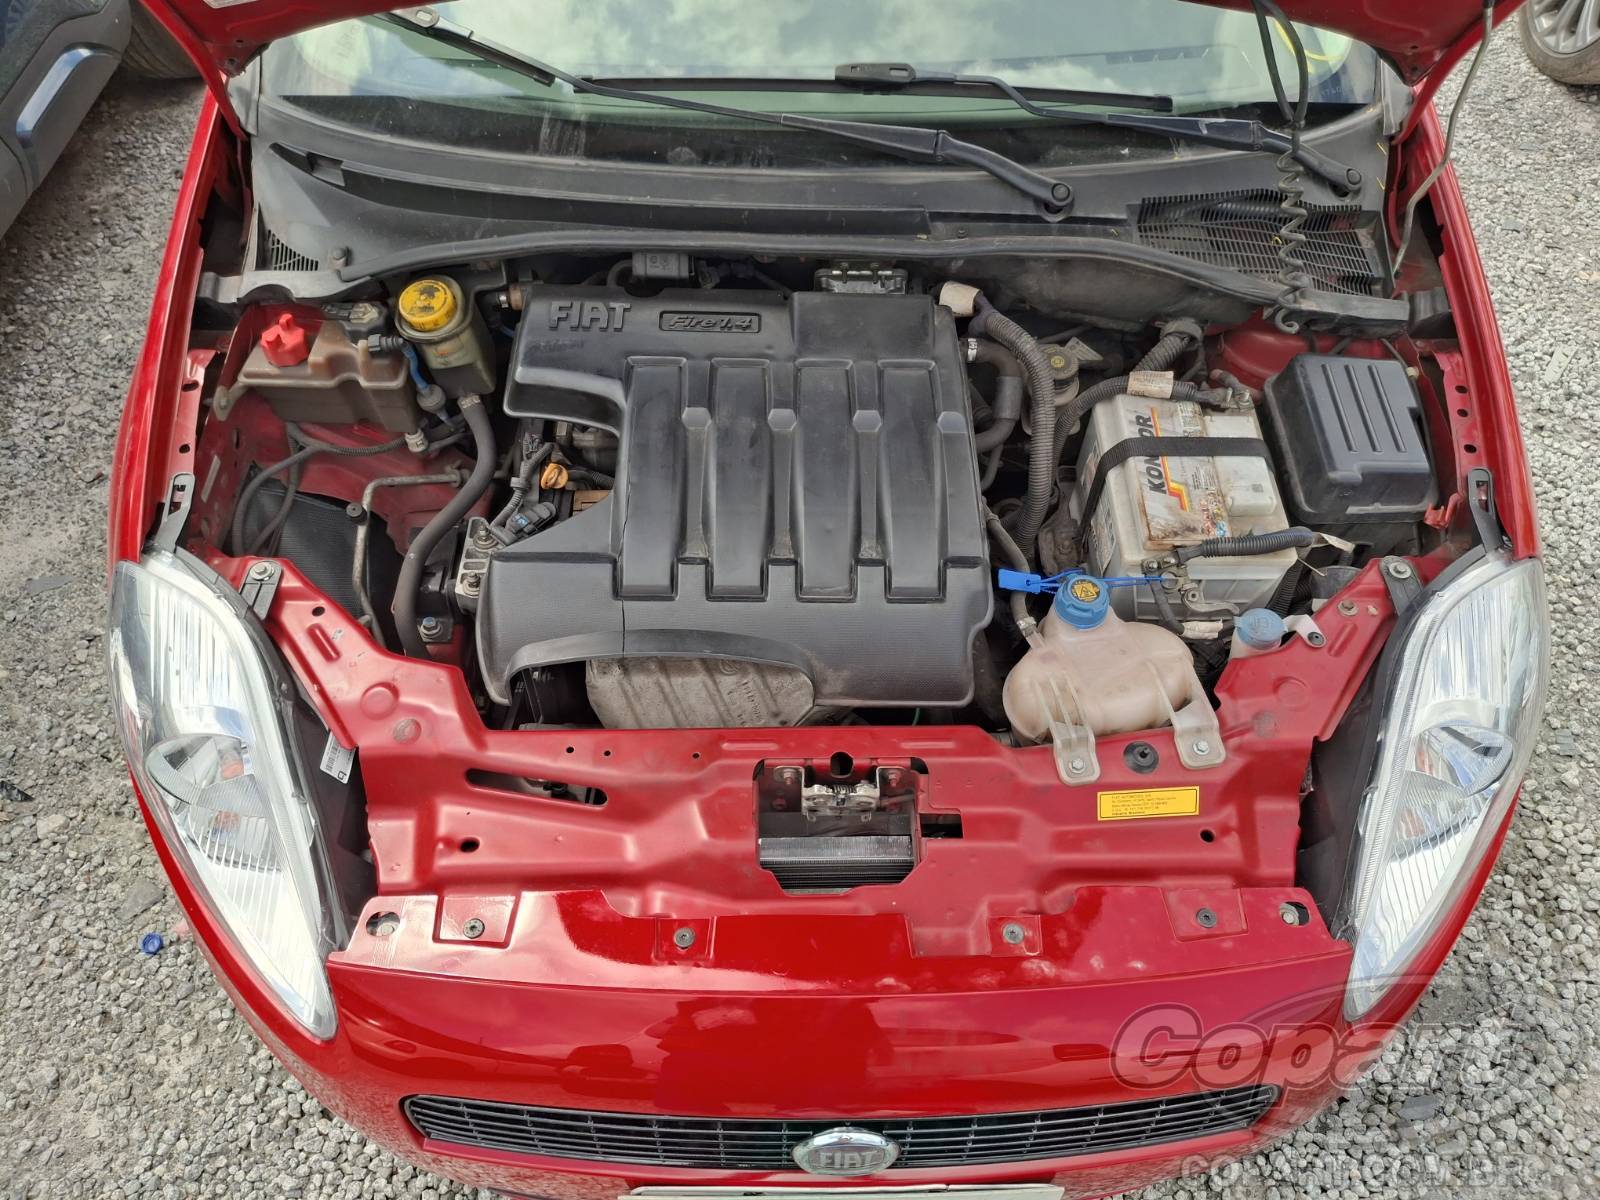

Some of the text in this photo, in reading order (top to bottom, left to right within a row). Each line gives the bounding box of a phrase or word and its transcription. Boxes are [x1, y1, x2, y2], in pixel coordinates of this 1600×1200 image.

[550, 301, 631, 332] FIAT
[1135, 414, 1167, 495] KONOR
[820, 1151, 874, 1169] FIAT
